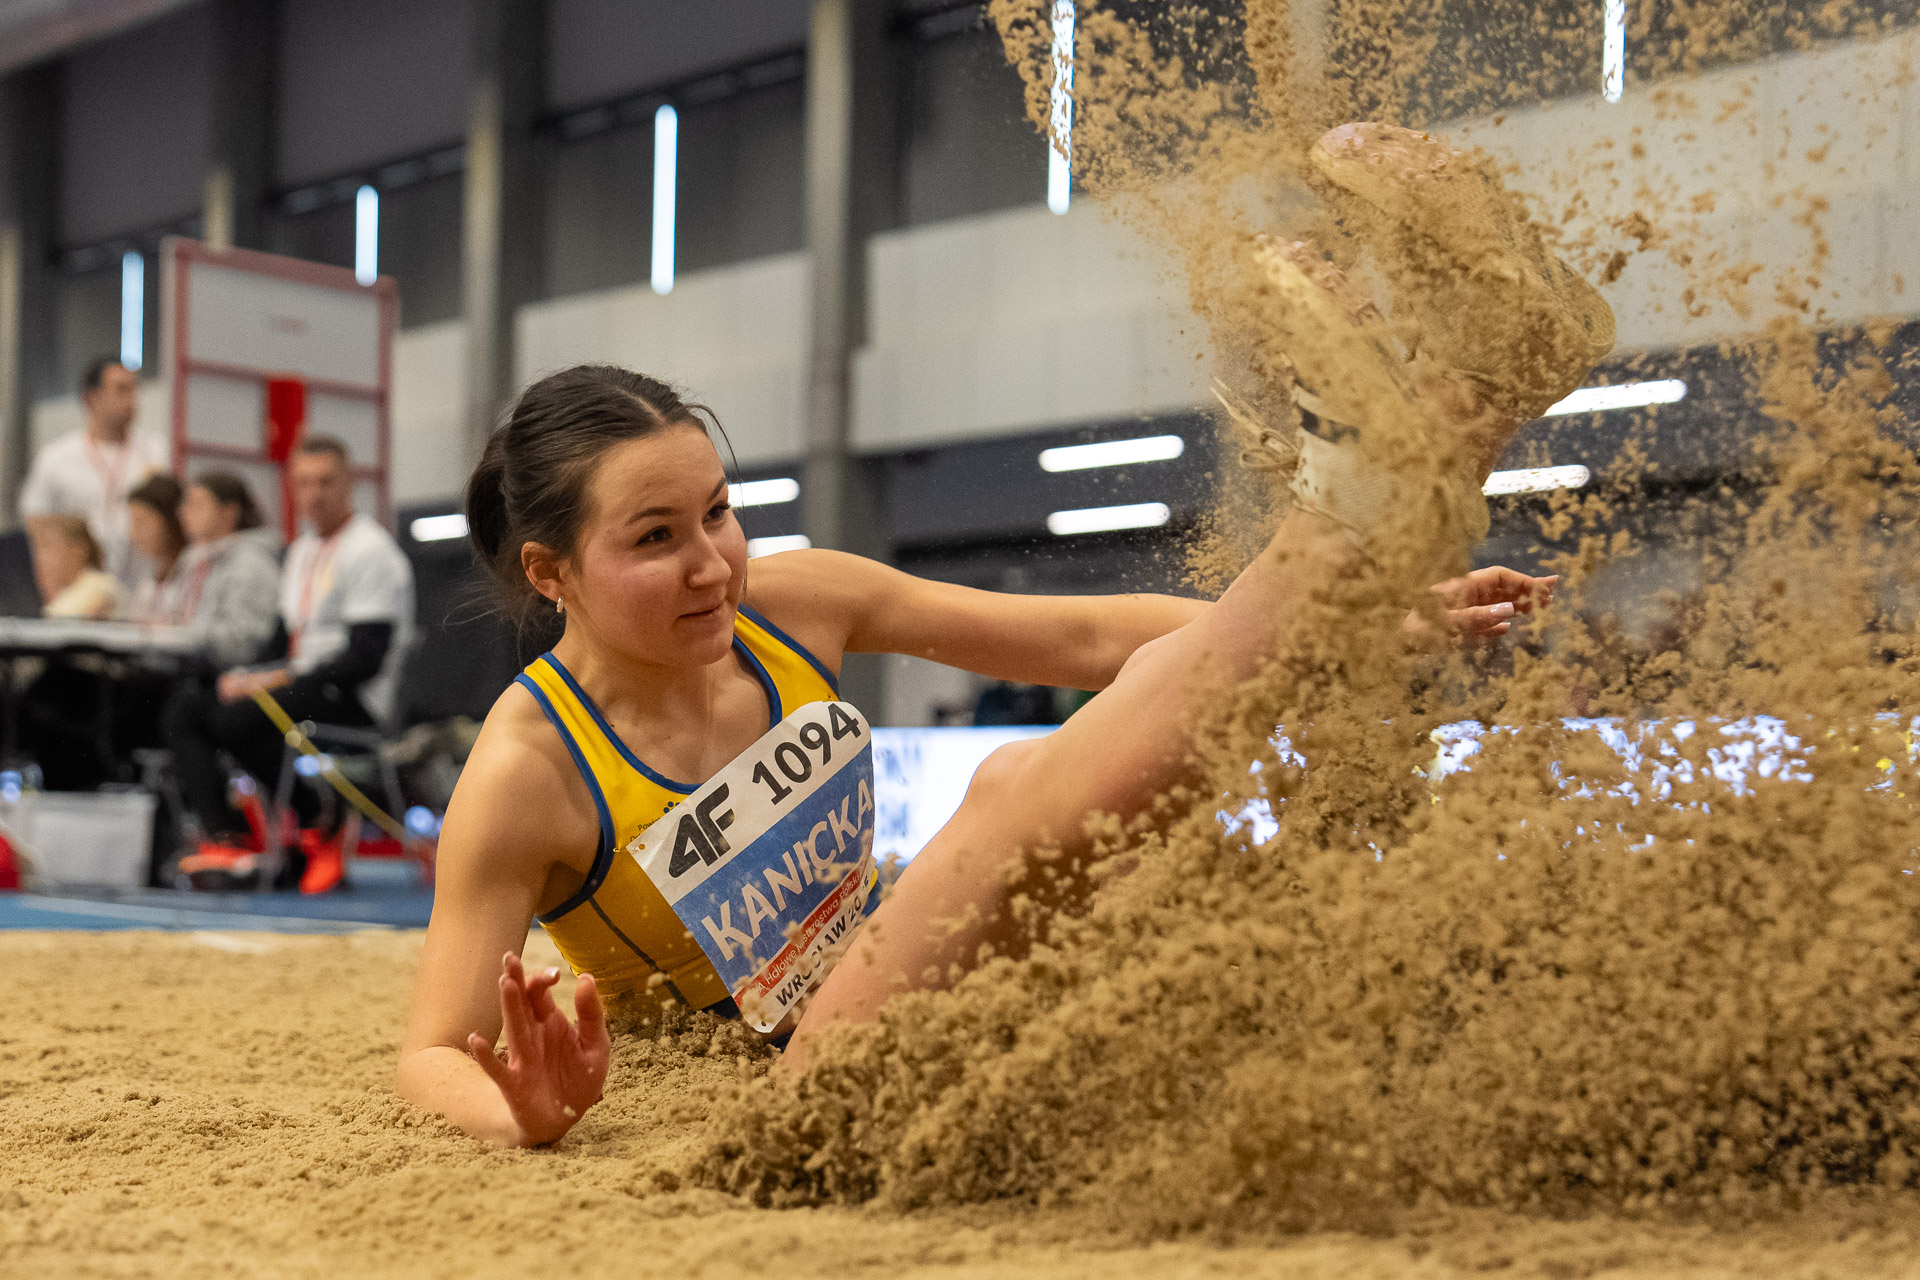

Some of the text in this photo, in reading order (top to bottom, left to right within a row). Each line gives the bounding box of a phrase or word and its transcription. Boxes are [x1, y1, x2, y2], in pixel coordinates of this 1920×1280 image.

[669, 782, 735, 878] 4F
[752, 703, 861, 805] 1094
[700, 778, 873, 962] KANICKA
